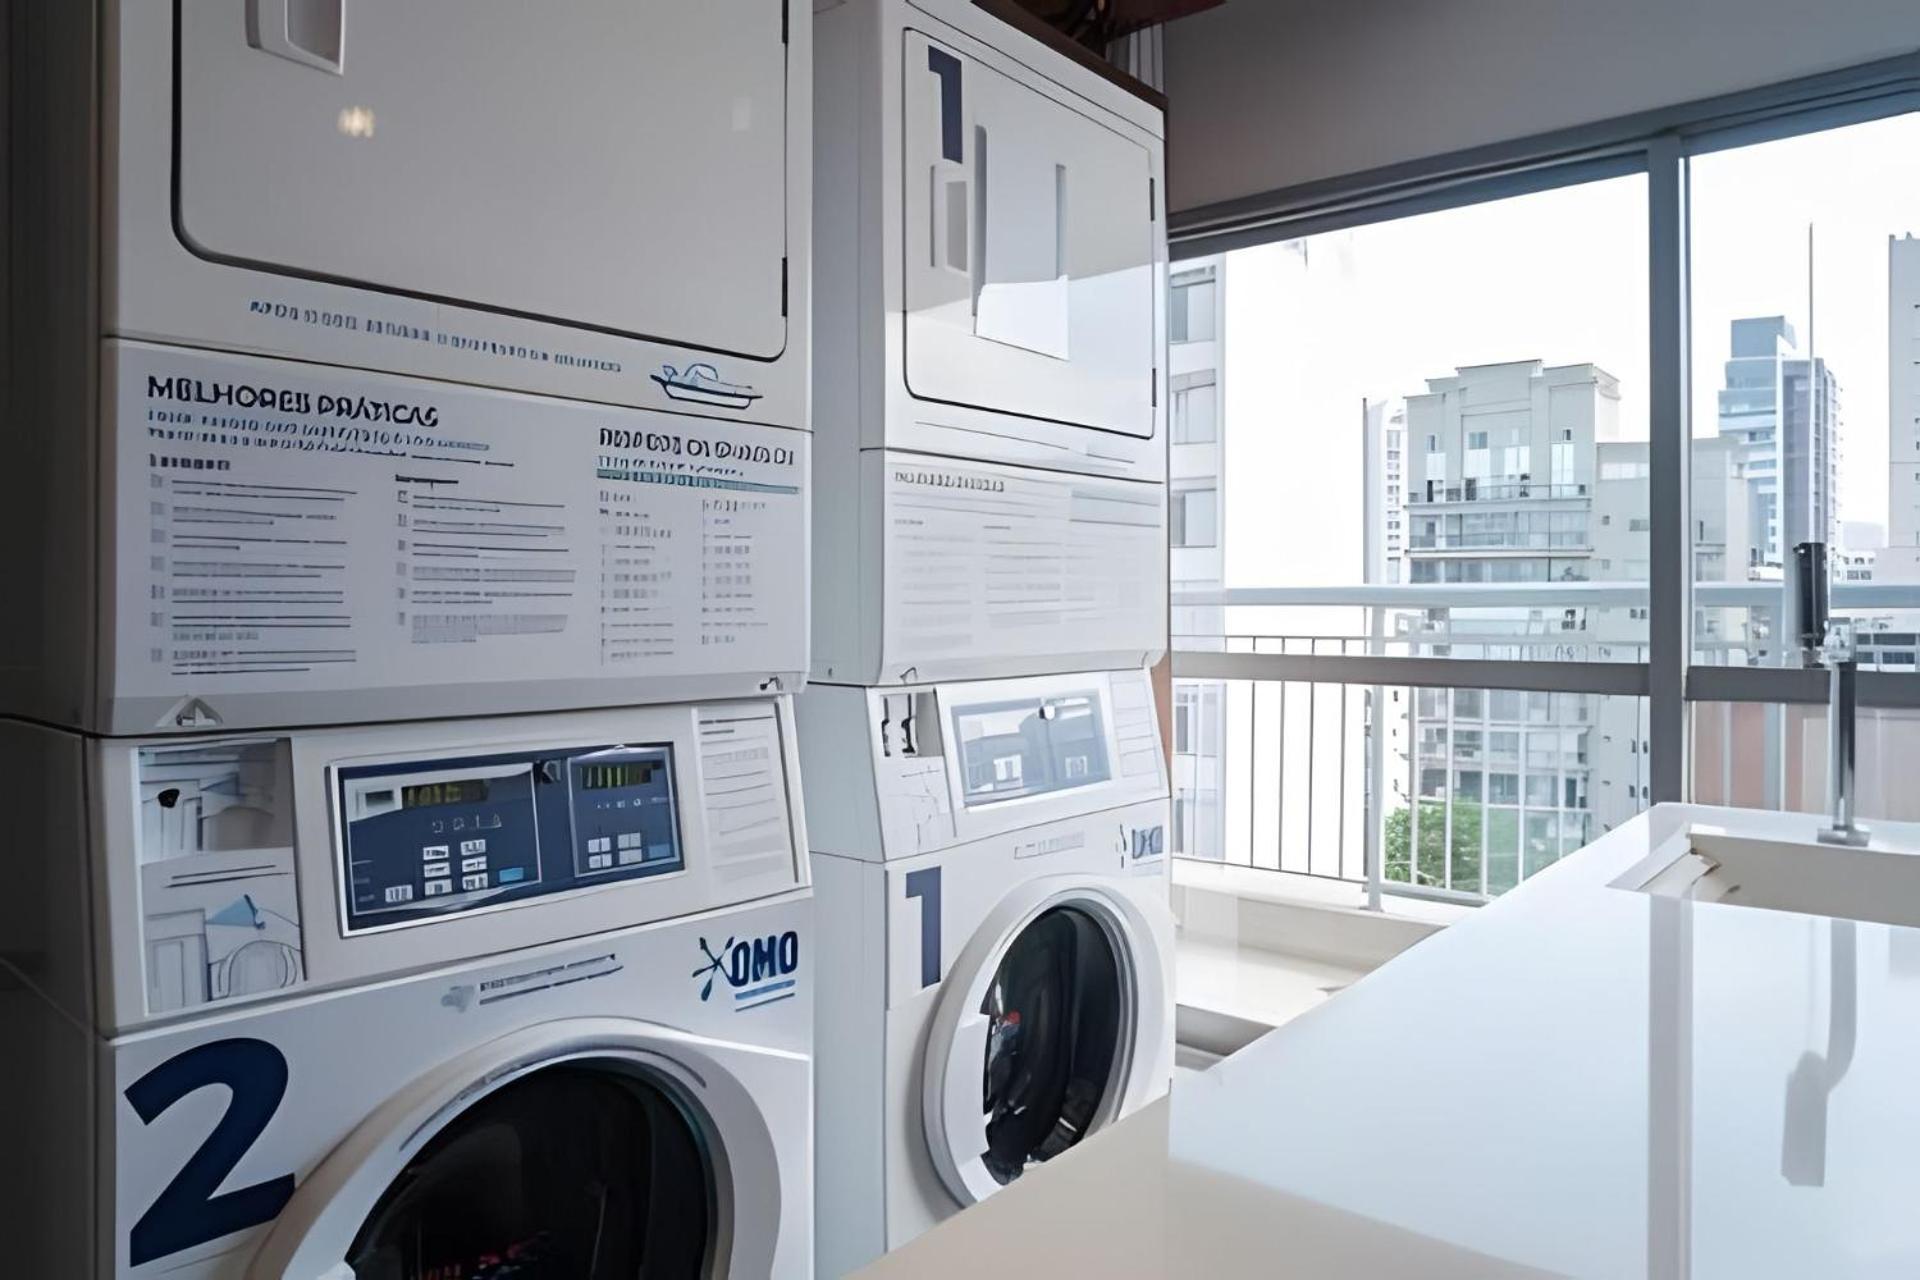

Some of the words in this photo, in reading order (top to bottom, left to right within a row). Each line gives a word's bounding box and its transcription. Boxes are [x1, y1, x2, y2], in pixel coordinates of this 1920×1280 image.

[927, 44, 963, 164] 1
[730, 929, 799, 987] OMO
[905, 865, 942, 989] 1
[123, 1037, 296, 1268] 2
